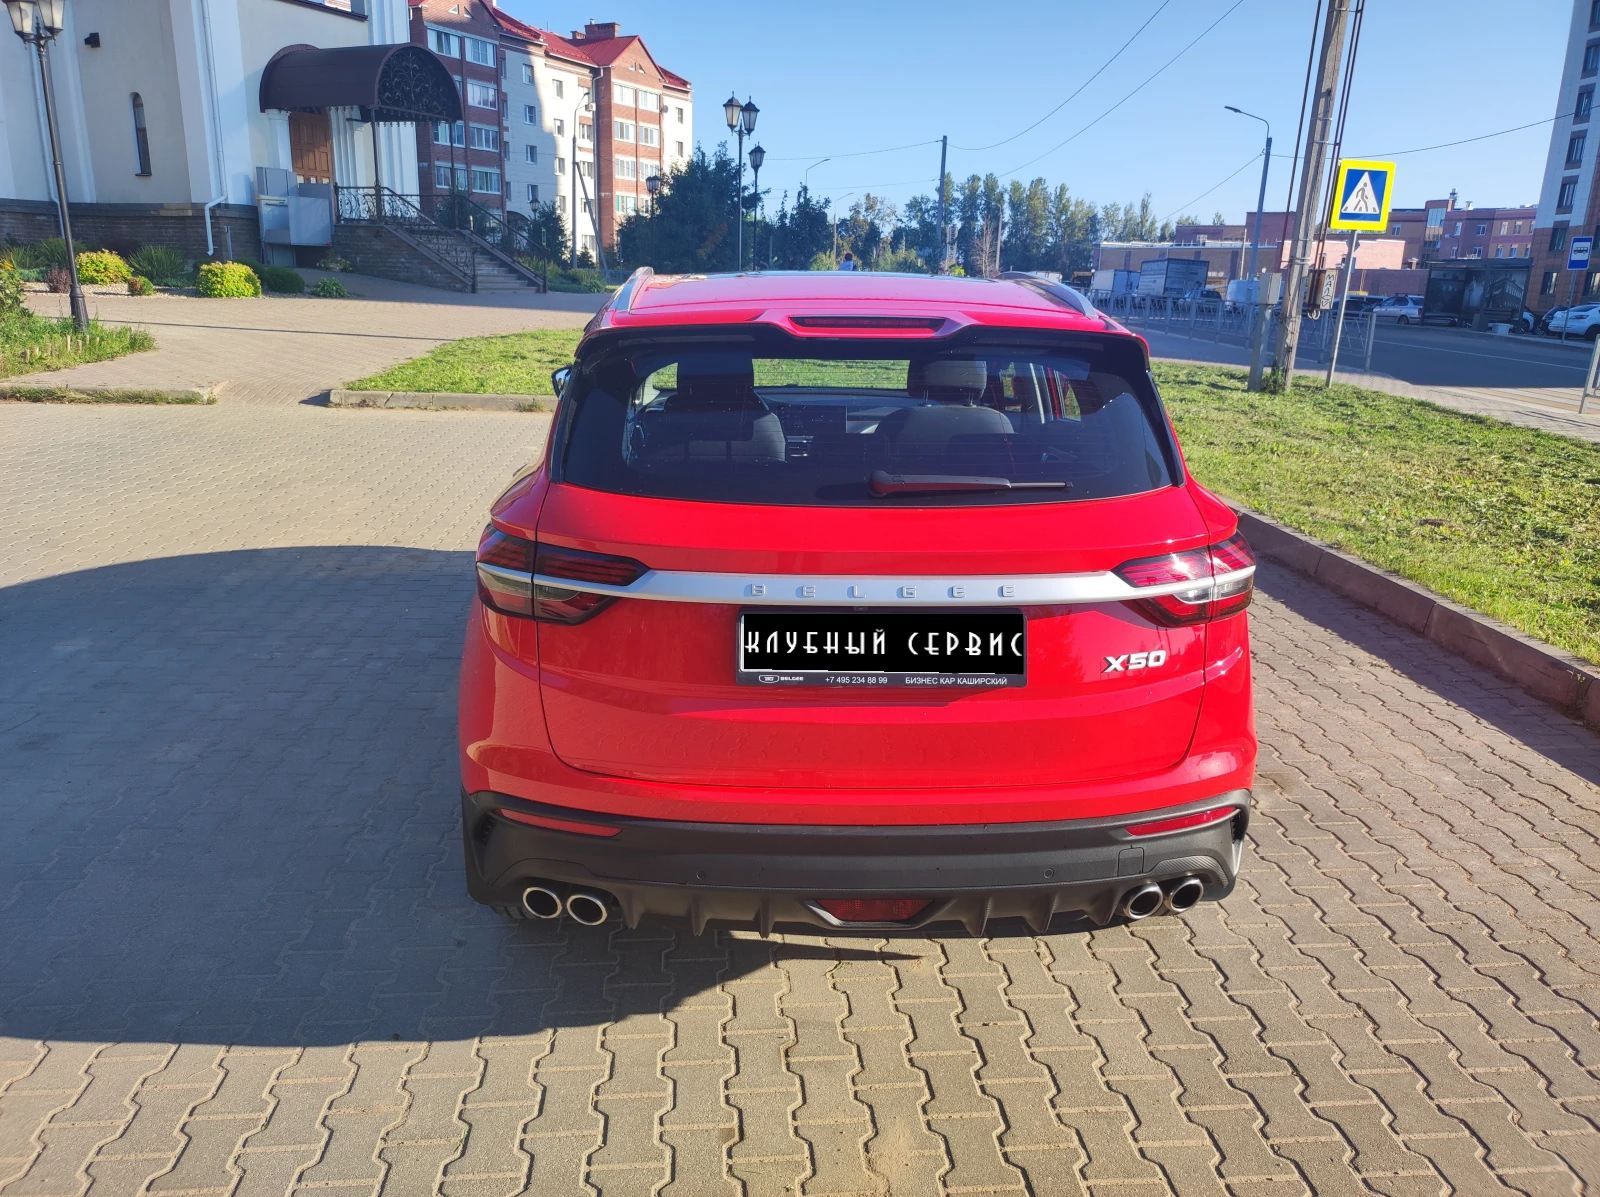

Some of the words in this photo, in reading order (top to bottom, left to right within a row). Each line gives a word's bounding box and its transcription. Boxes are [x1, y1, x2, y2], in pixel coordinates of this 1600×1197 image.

[750, 583, 1016, 598] BELGEE
[1101, 649, 1167, 673] X50
[825, 676, 835, 684] +7
[836, 676, 850, 684] 495
[851, 676, 866, 684] 234
[867, 676, 877, 684] 88
[878, 676, 888, 684] 99
[905, 677, 938, 685] БИЗНЕС
[940, 677, 956, 685] КАР
[958, 676, 1008, 685] КАШИРСКИЙ
